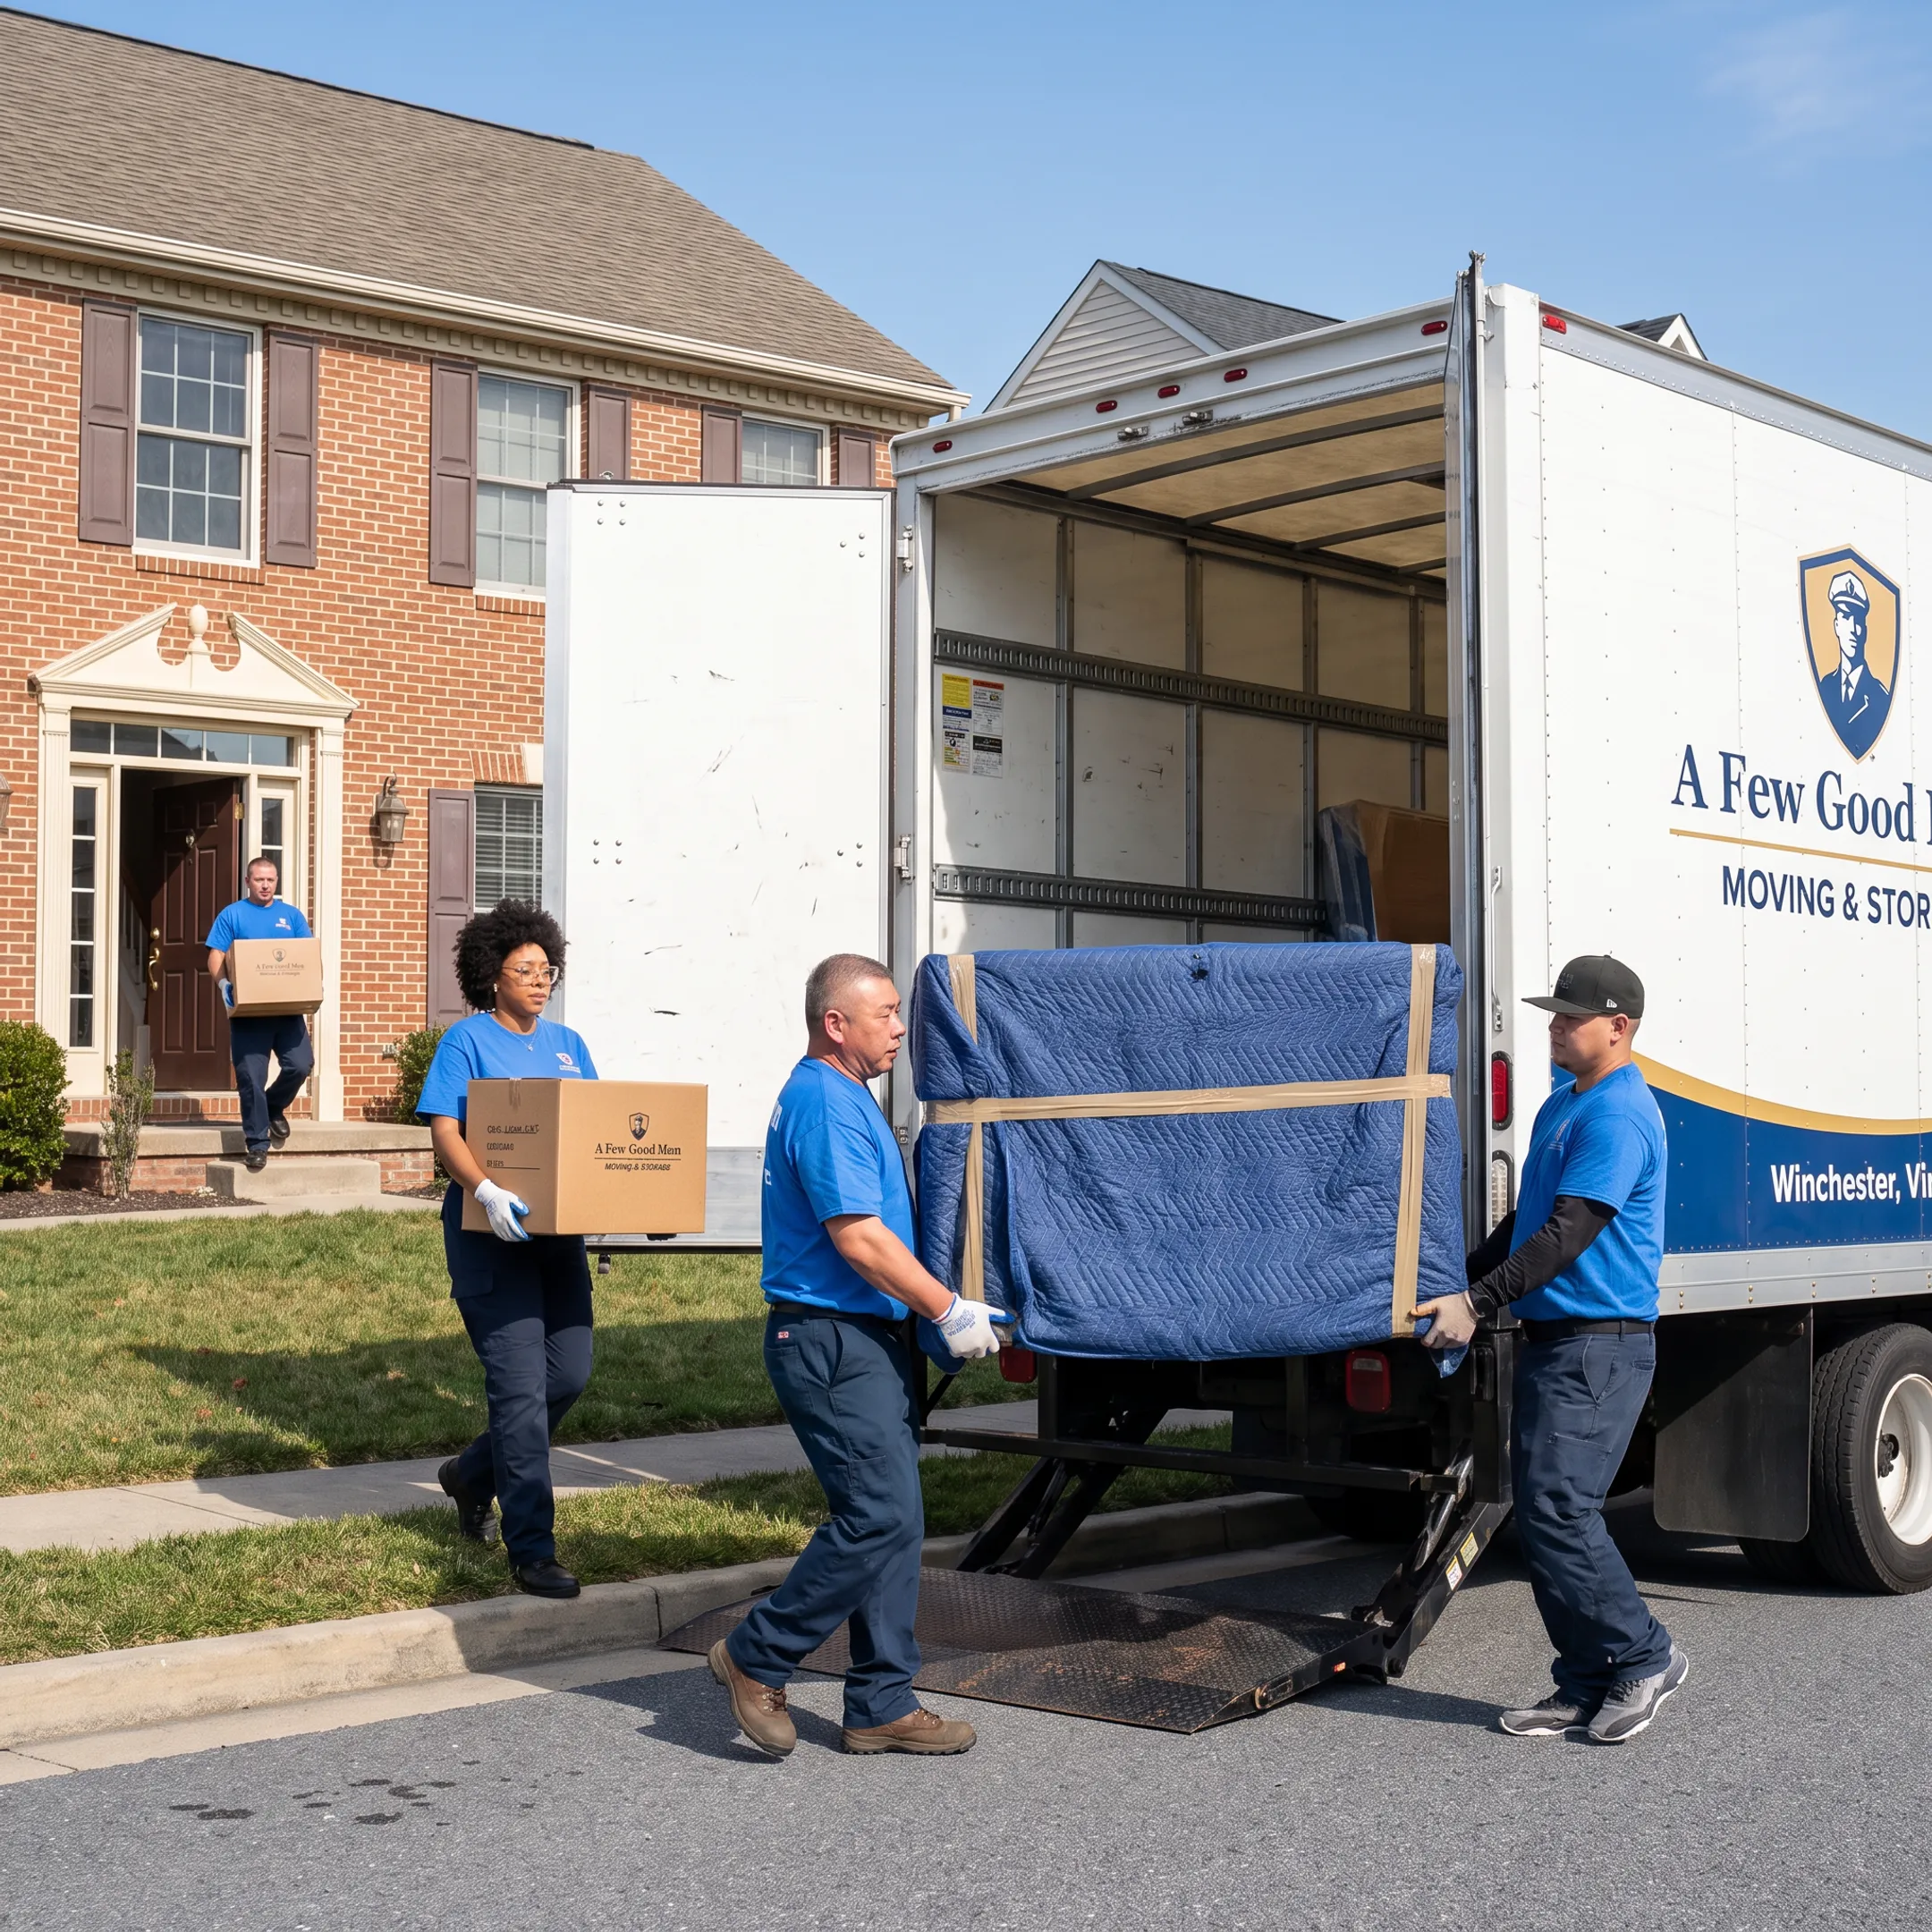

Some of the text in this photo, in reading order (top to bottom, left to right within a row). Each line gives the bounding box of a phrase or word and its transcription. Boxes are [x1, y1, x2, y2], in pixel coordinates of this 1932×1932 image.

[1671, 744, 1708, 809] A
[1718, 750, 1805, 824] Few
[1816, 770, 1916, 842] Good
[1722, 865, 1931, 929] MOVING & STOR
[595, 1143, 603, 1154] A
[606, 1143, 626, 1154] Few
[629, 1144, 656, 1155] Good
[1770, 1163, 1901, 1205] Winchester,
